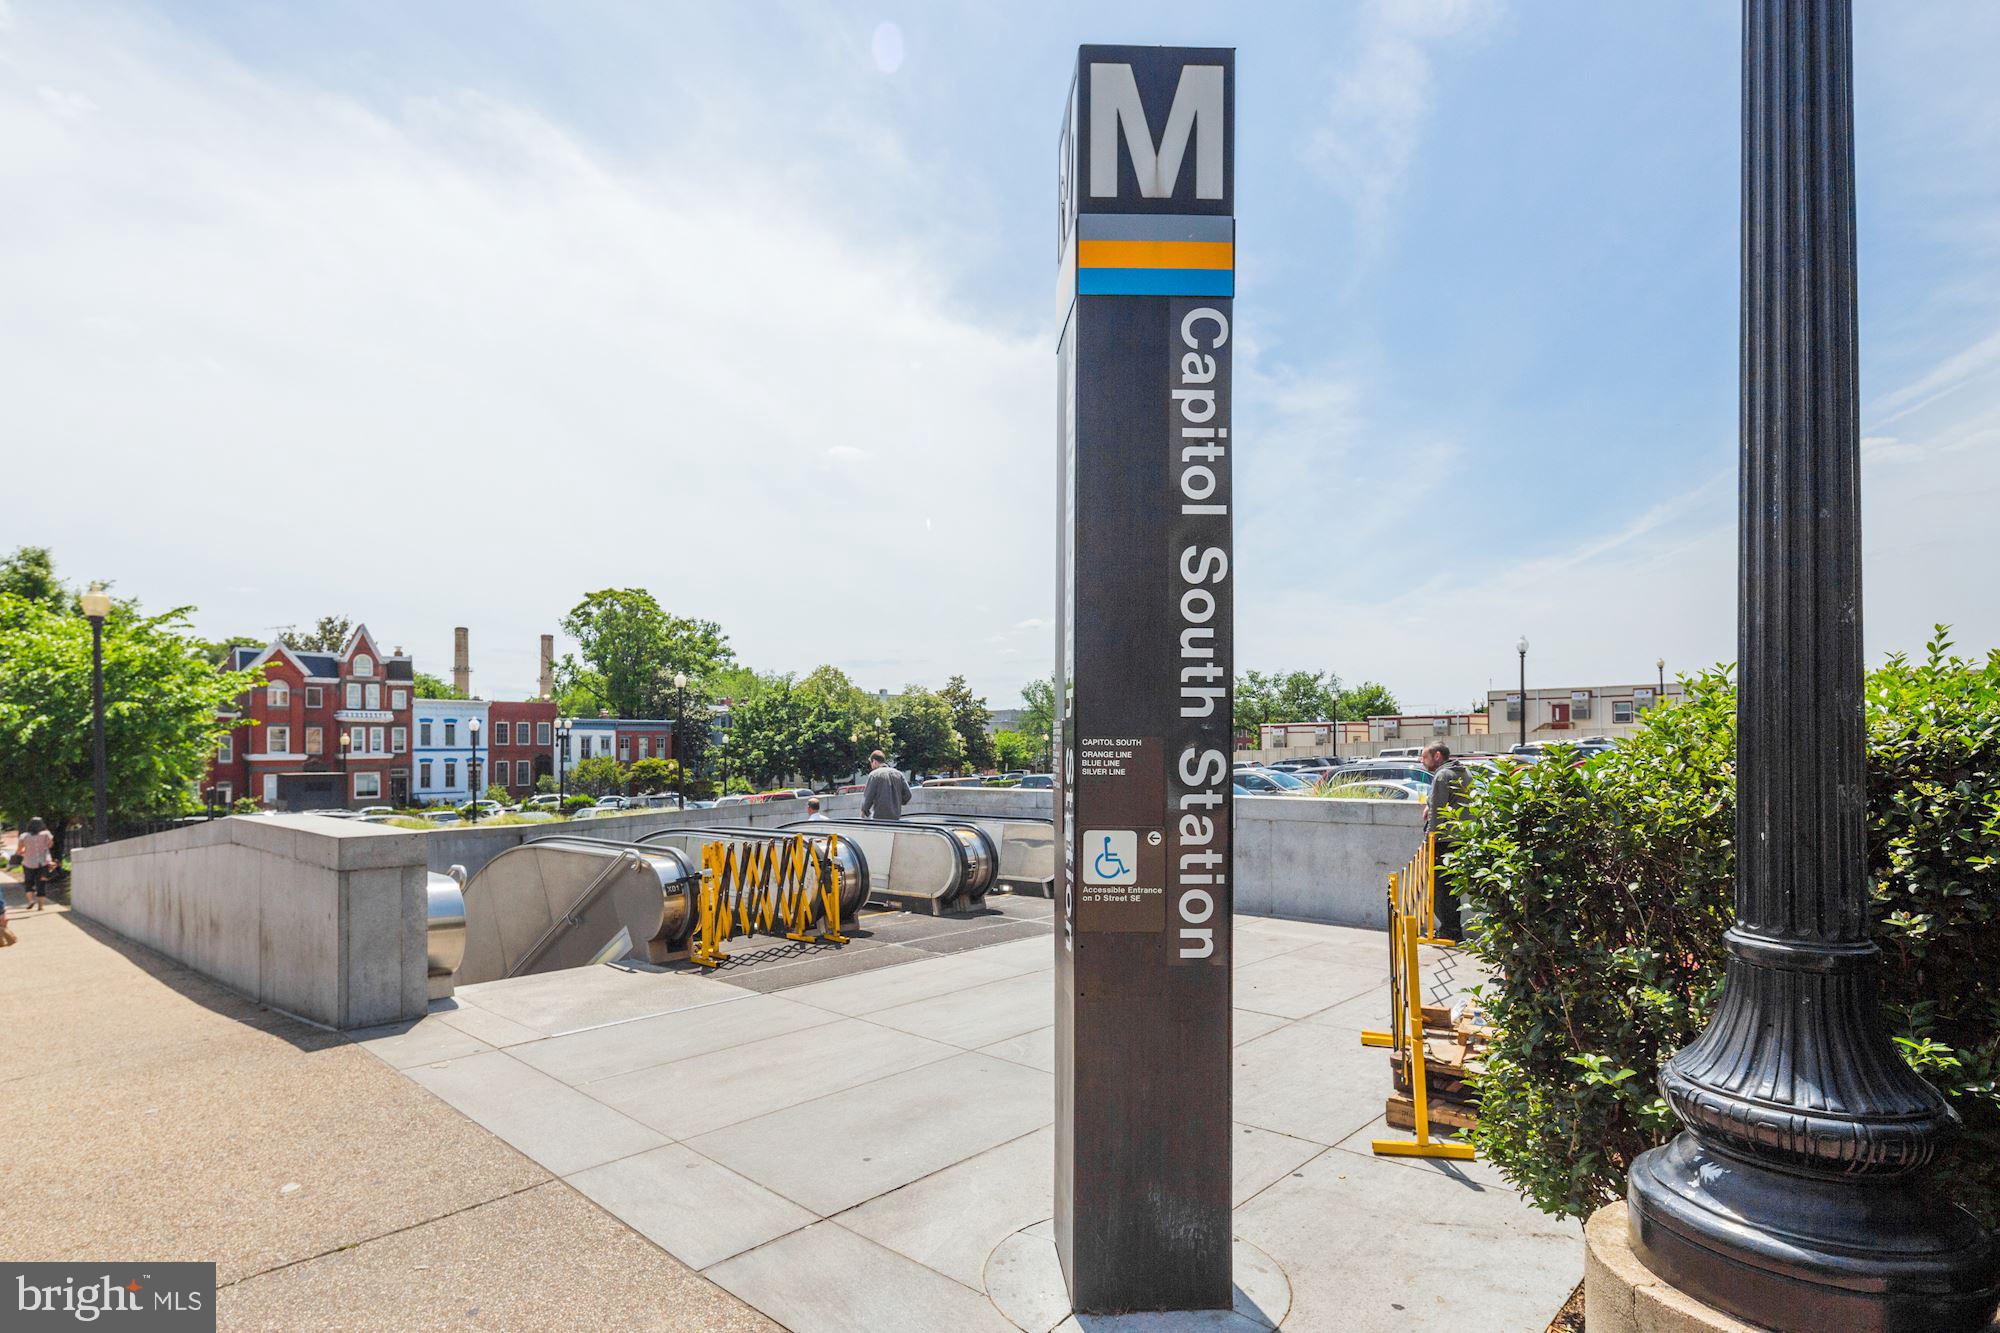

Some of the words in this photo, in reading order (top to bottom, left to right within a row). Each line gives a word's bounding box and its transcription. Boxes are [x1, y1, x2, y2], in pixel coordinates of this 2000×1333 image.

[1090, 62, 1224, 200] M
[1171, 307, 1229, 515] Capitol
[1179, 545, 1229, 718] South
[1082, 738, 1114, 746] CAPITOL
[1115, 738, 1142, 746] SOUTH
[1109, 768, 1126, 776] LINE
[1115, 751, 1132, 759] LINE
[1065, 747, 1075, 952] Station
[1082, 886, 1126, 894] Accessible
[1127, 886, 1163, 894] Entrance
[1178, 747, 1227, 959] Station
